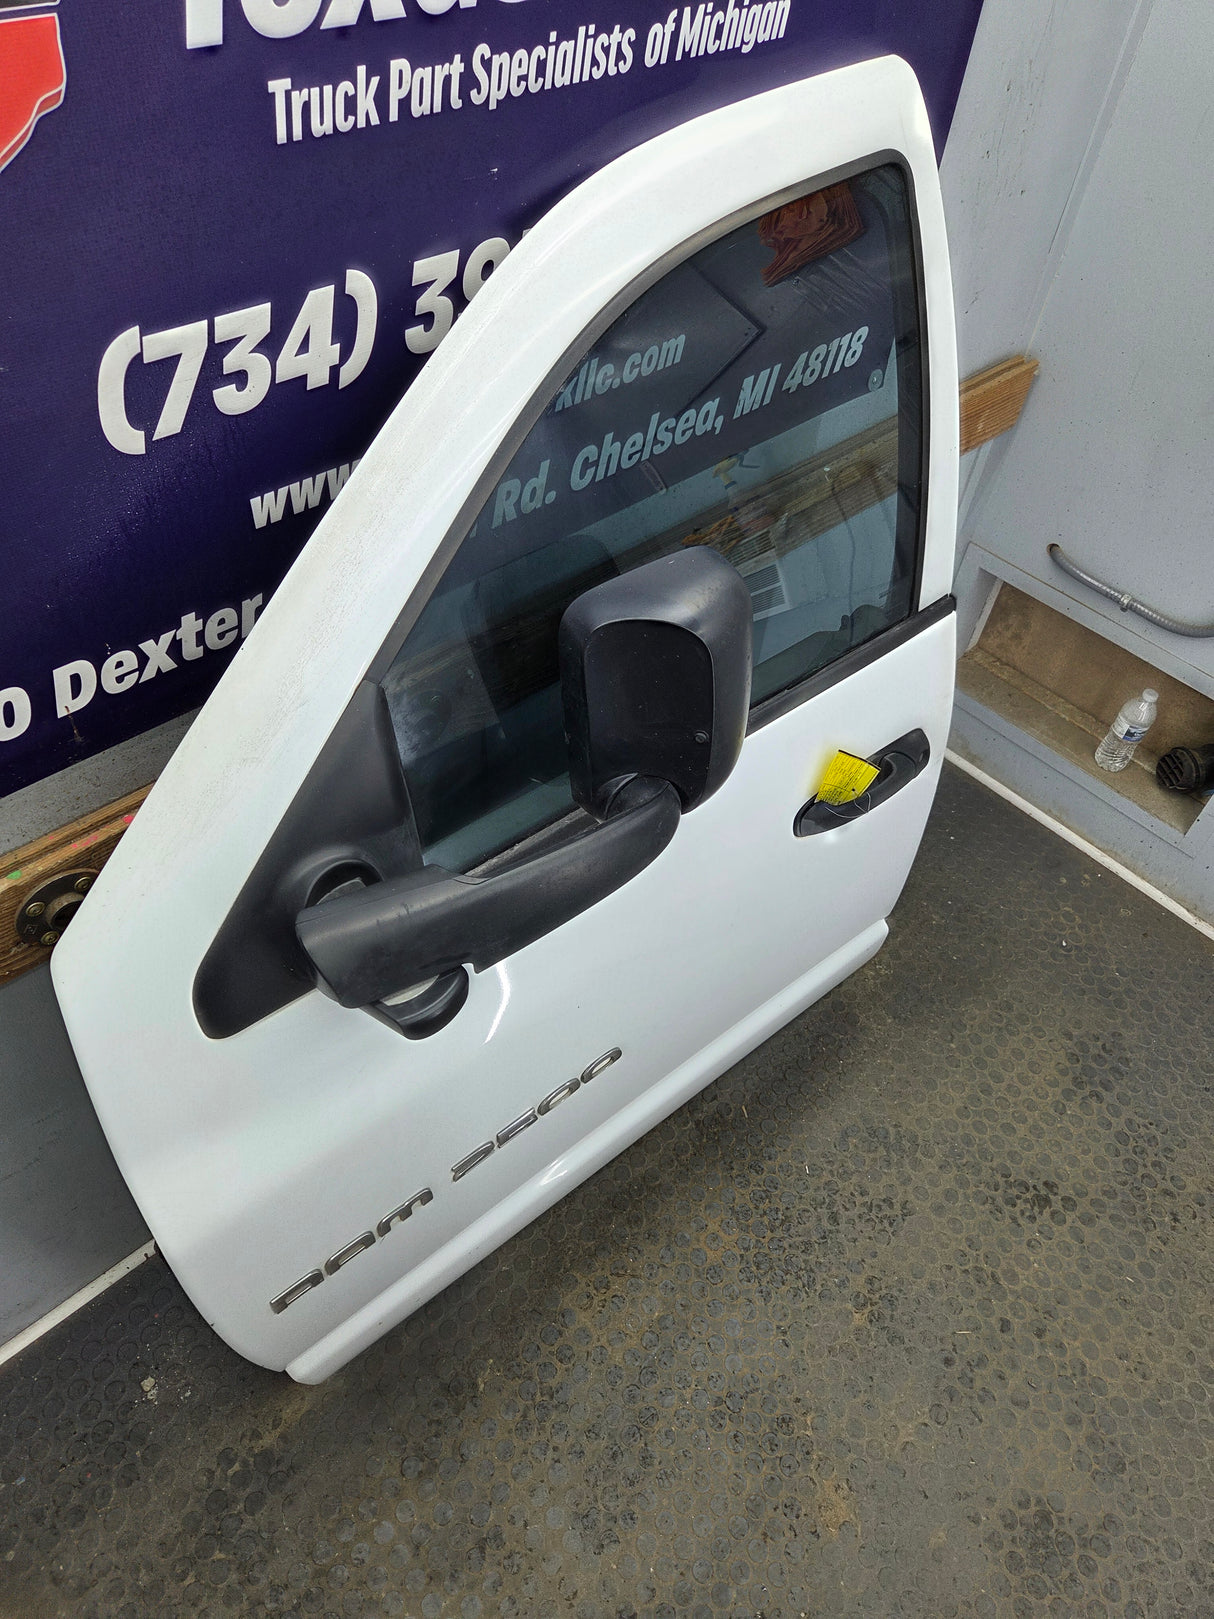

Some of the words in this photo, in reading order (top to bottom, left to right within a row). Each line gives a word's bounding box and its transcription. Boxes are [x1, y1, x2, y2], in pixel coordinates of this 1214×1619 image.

[267, 65, 381, 145] Truck
[388, 53, 464, 122] Part
[470, 24, 636, 110] Specialists
[644, 9, 678, 68] of
[675, 0, 791, 61] Michigan
[97, 269, 378, 455] (734)
[53, 592, 263, 719] Dexter
[491, 459, 557, 529] Rd.
[570, 397, 724, 491] Chelsea,
[733, 363, 782, 420] MI
[781, 326, 869, 394] 48118
[451, 1046, 623, 1182] 2500
